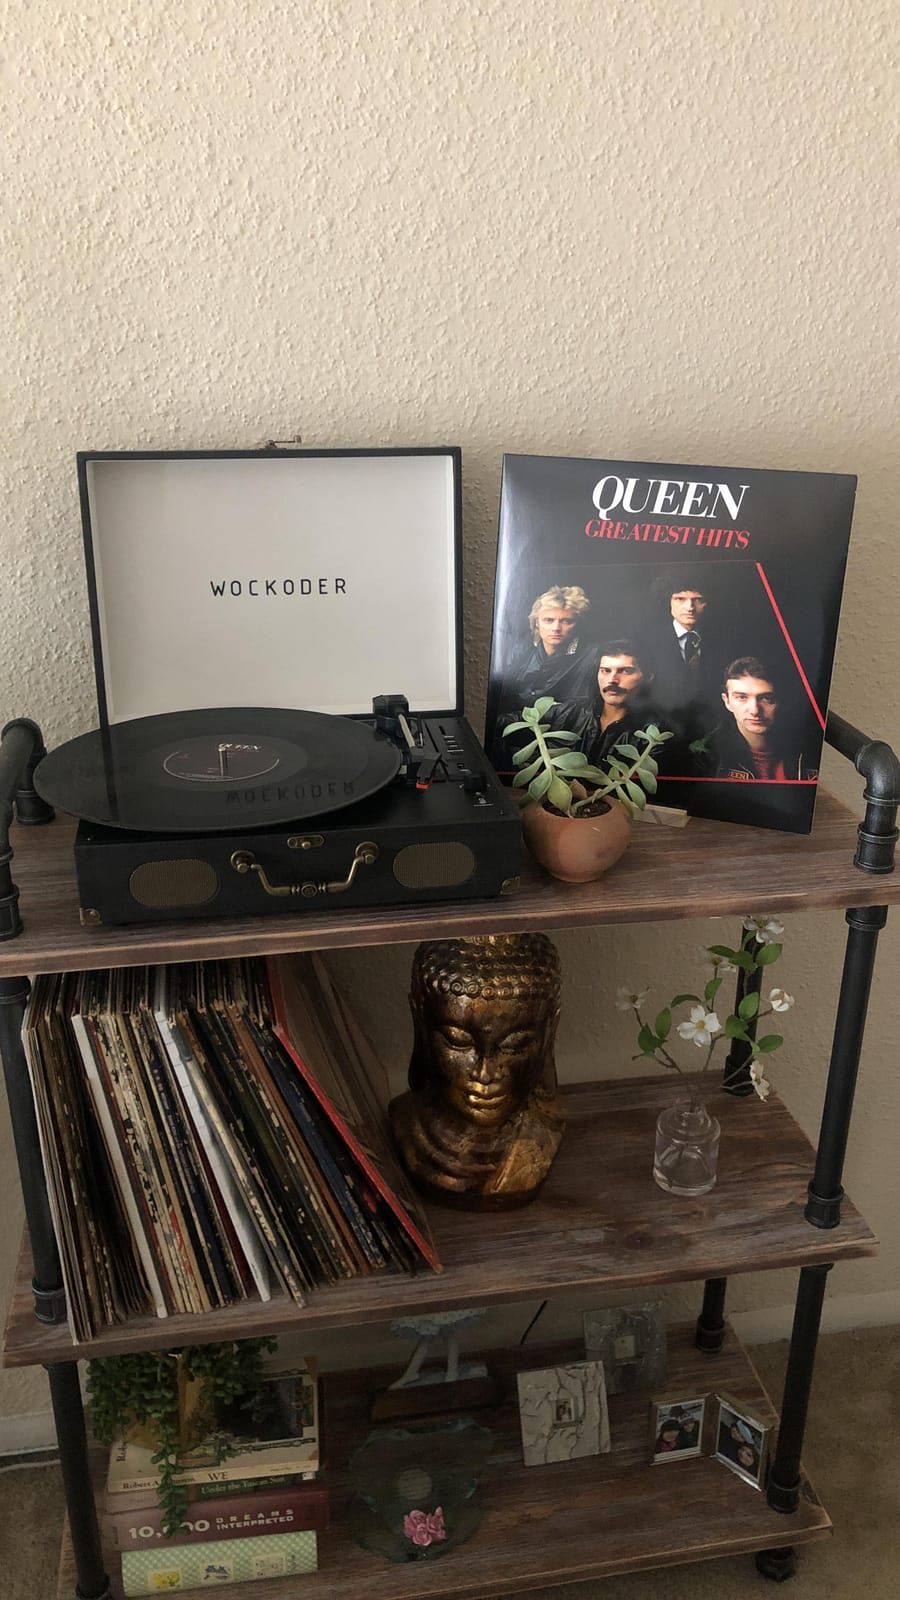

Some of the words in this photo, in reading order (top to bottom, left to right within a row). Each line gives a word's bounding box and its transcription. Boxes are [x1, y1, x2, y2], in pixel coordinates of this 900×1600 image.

[592, 475, 750, 521] QUEEN
[585, 519, 695, 545] GREATEST
[696, 527, 751, 550] HITS
[210, 578, 346, 597] WOCKODER
[208, 1472, 229, 1481] WE
[201, 1484, 226, 1495] Under
[228, 1481, 242, 1491] the
[216, 1509, 294, 1523] DREAMS
[217, 1515, 294, 1530] INTERPRETED
[128, 1519, 210, 1539] 10,0
